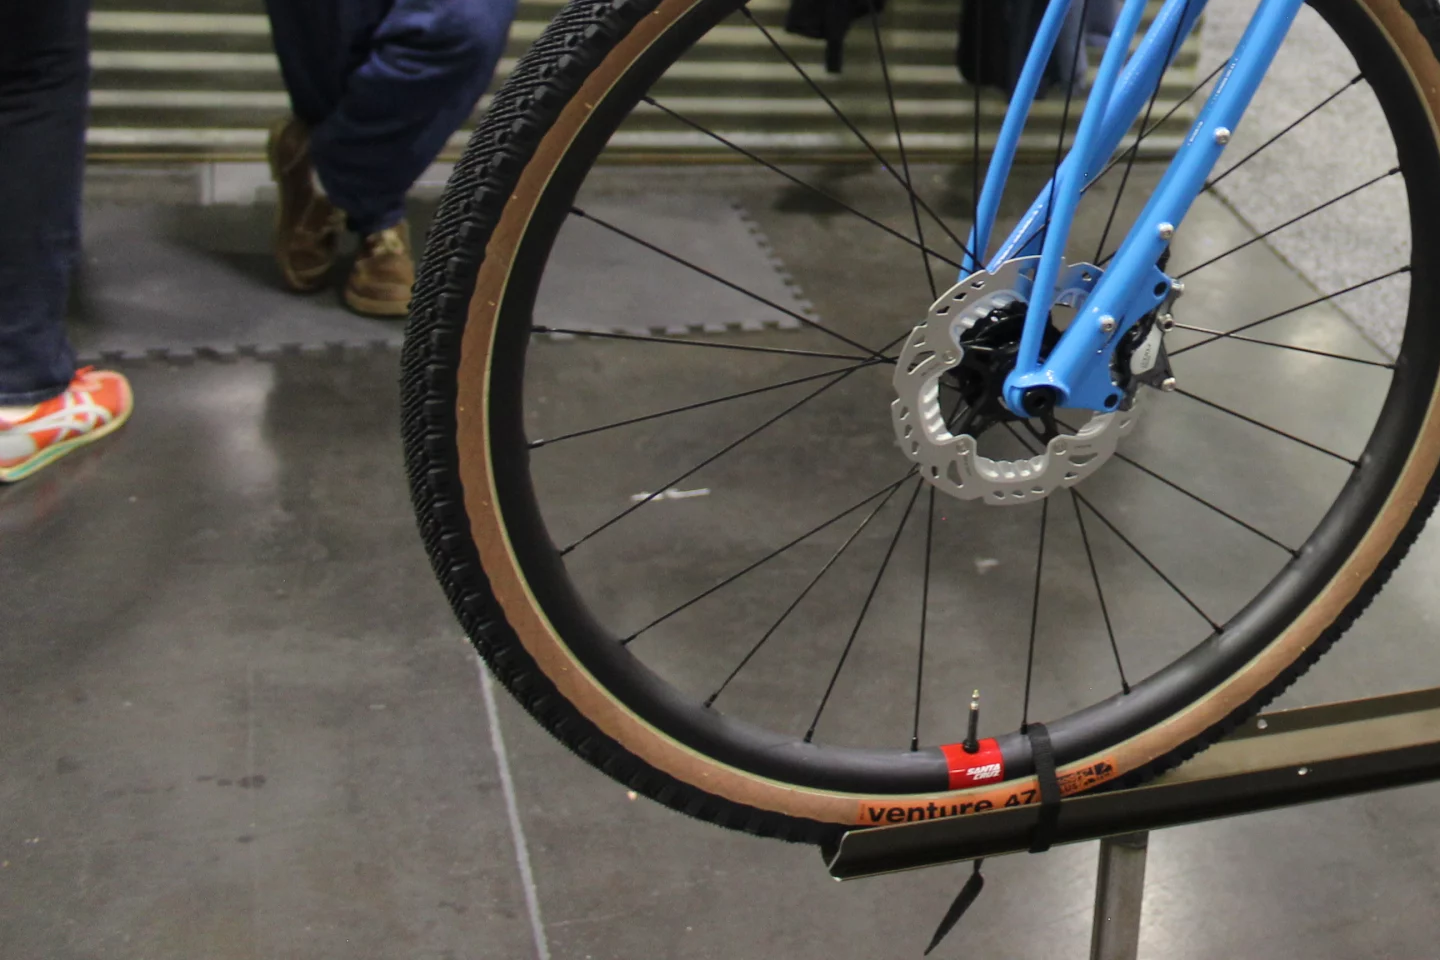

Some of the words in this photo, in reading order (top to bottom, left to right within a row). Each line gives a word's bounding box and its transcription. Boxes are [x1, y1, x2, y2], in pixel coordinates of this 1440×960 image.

[966, 763, 1001, 777] SANTA
[972, 770, 1001, 781] CRUZ
[867, 798, 994, 824] venture
[1003, 788, 1038, 808] 47
